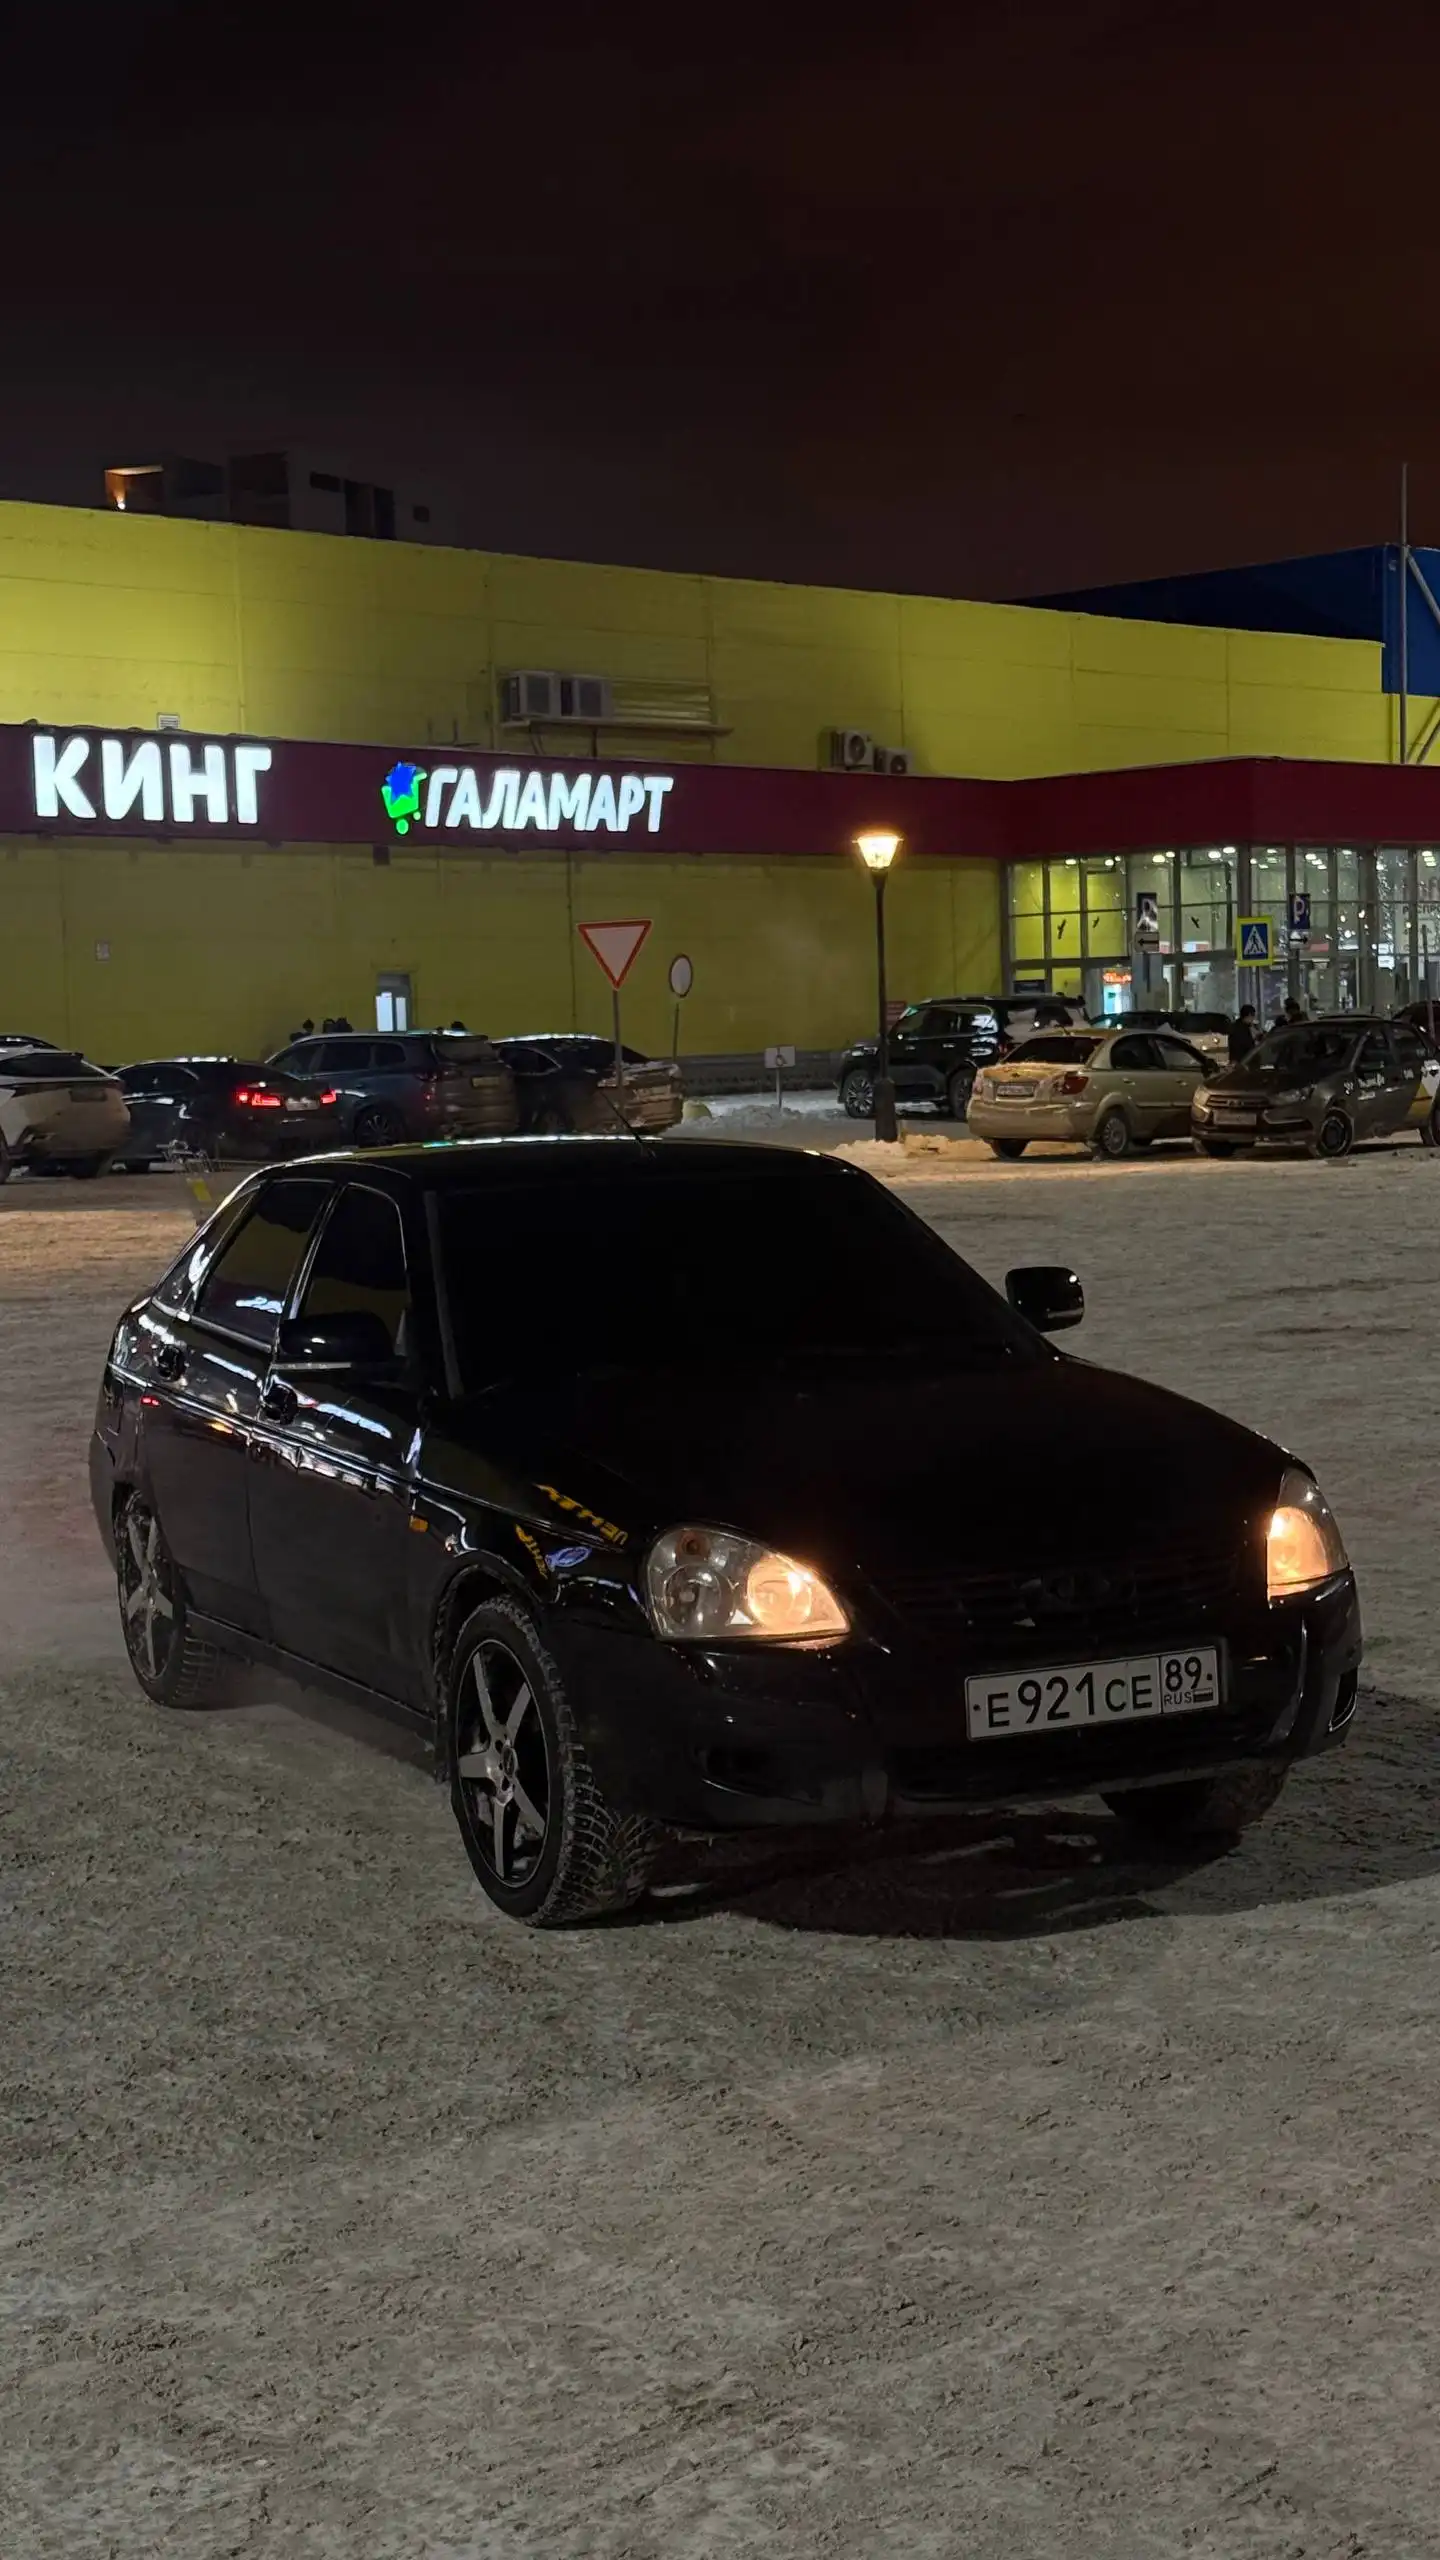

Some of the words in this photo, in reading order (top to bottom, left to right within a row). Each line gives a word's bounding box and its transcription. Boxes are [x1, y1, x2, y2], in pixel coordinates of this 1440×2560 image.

[33, 735, 272, 824] КИНГ
[424, 768, 674, 833] ГАЛАМАРТ
[987, 1671, 1153, 1729] Е921СЕ
[1164, 1656, 1202, 1692] 89
[1163, 1691, 1194, 1706] RUS
